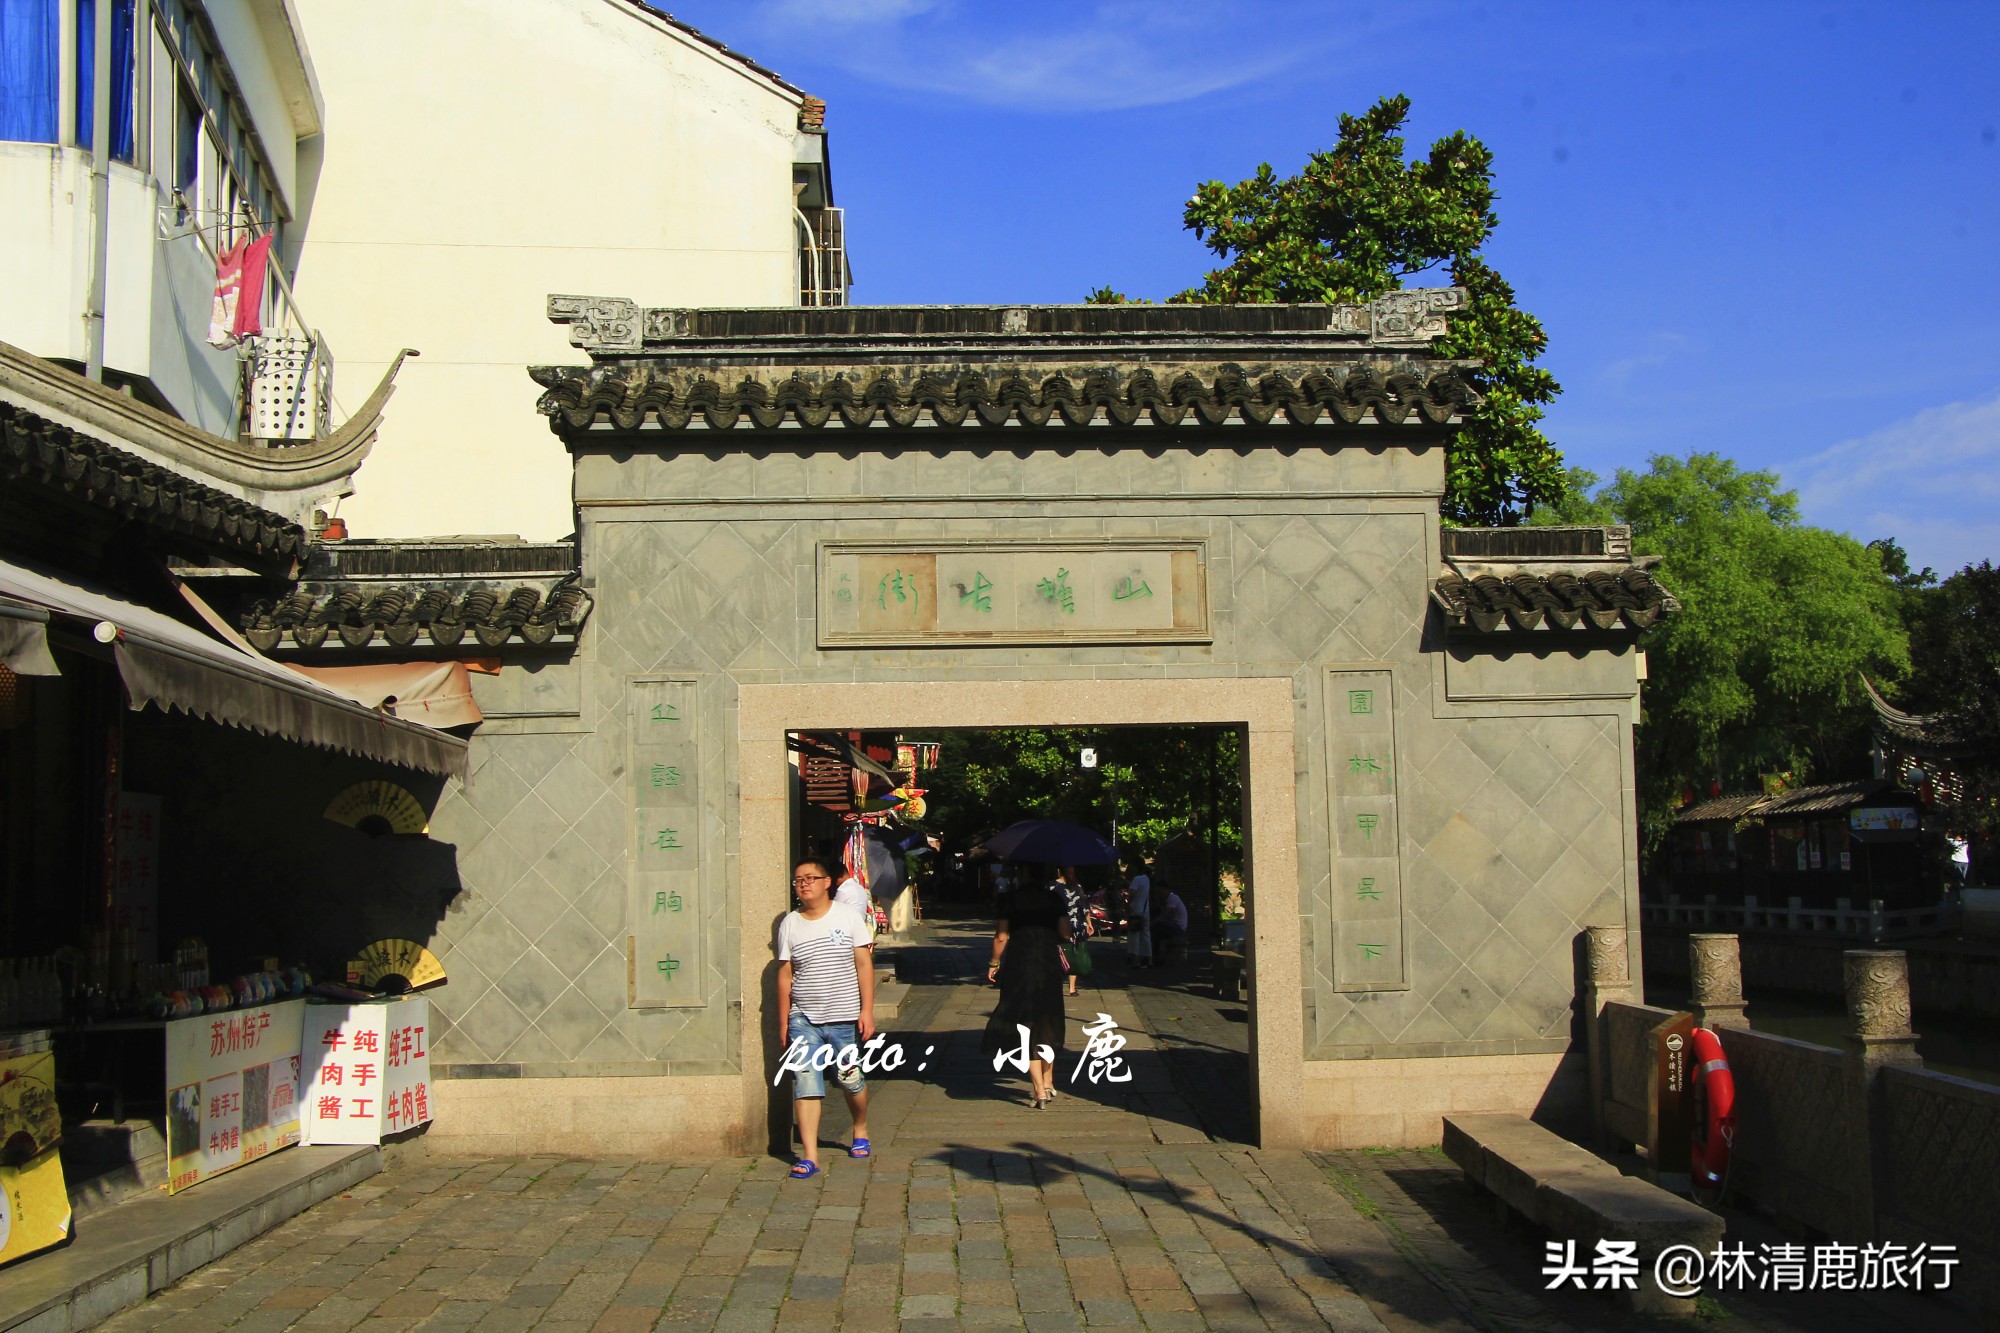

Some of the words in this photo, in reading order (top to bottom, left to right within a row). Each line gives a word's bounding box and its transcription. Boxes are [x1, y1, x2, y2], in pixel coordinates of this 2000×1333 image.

[210, 1012, 271, 1058] 苏州特产
[388, 1026, 425, 1067] 纯手工
[318, 1029, 347, 1119] 牛肉酱
[349, 1029, 379, 1118] 纯手工
[210, 1092, 240, 1119] 纯手工
[387, 1082, 428, 1130] 牛肉酱
[209, 1127, 239, 1155] 牛肉酱
